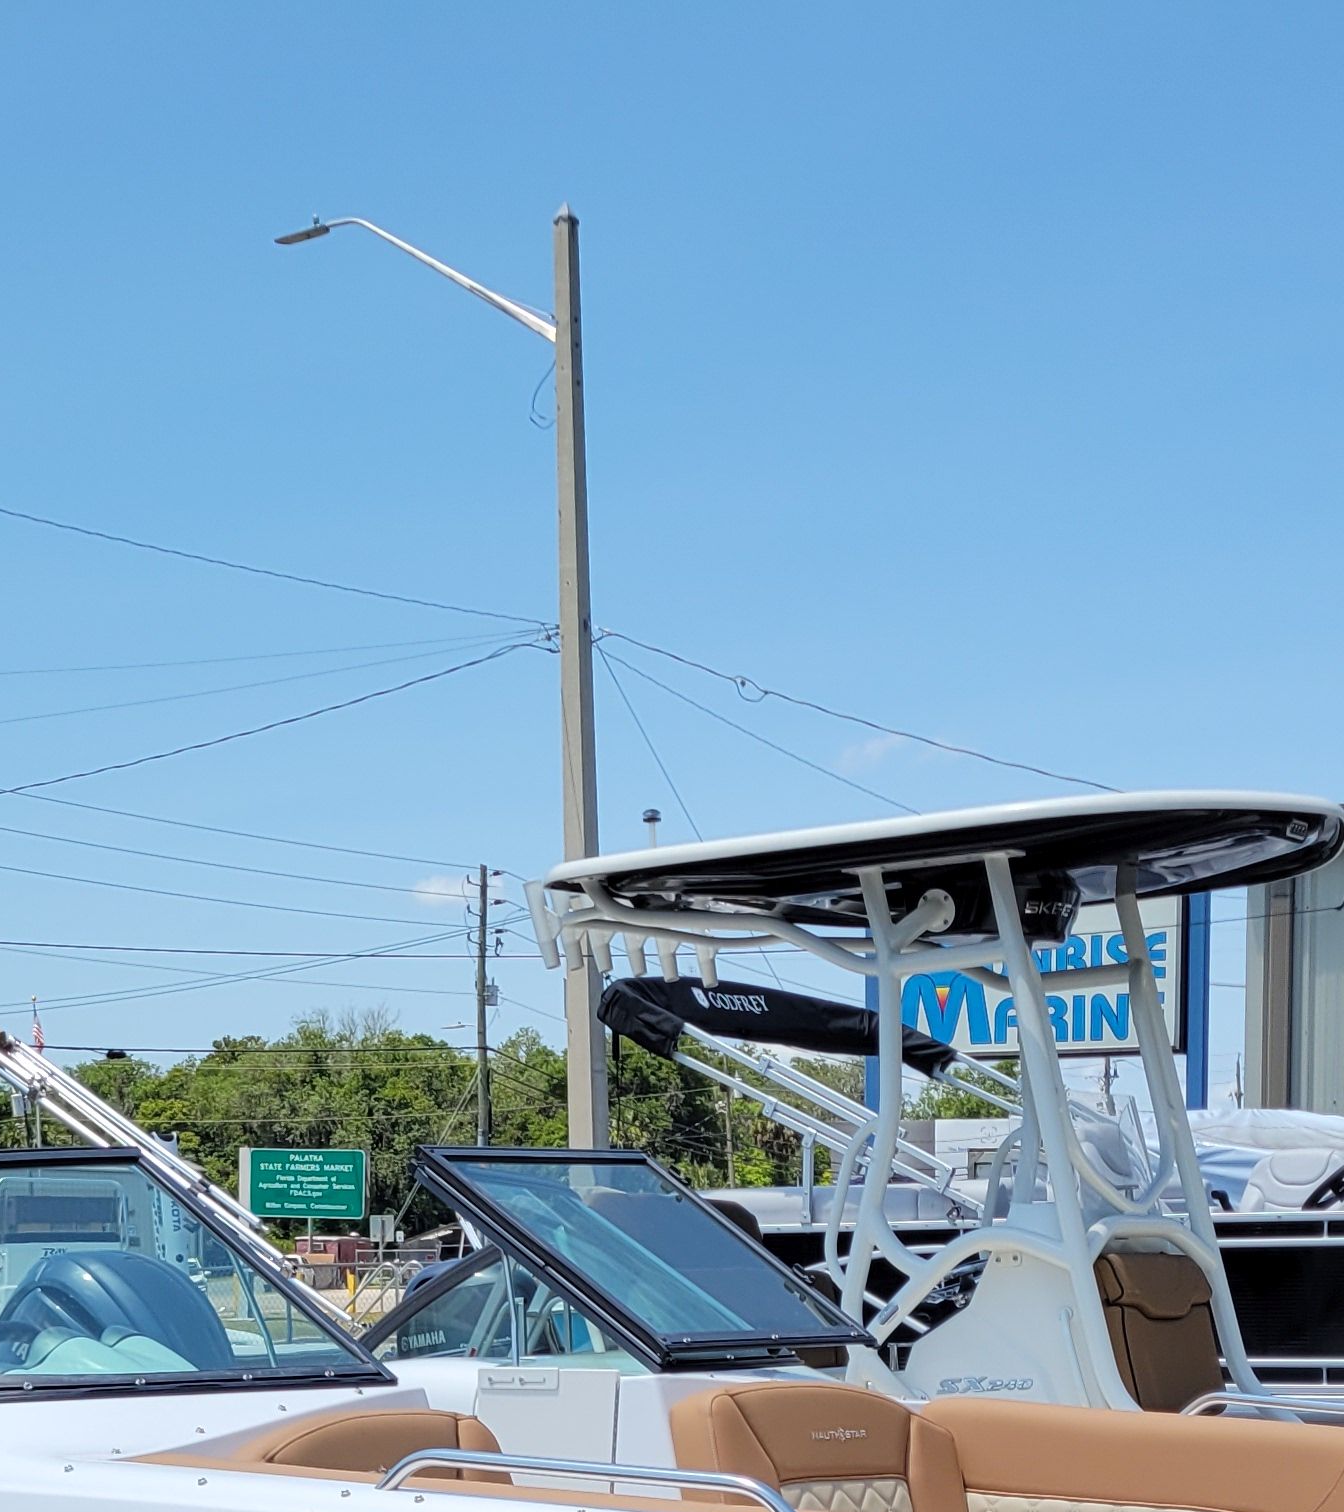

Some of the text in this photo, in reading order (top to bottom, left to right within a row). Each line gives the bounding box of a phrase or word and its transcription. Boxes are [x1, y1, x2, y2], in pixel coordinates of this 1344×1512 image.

[708, 991, 769, 1015] GODFREY
[901, 968, 1165, 1045] MARIN
[259, 1163, 354, 1172] STATE FARMERS MARKET
[289, 1154, 324, 1162] PALATKA
[408, 1329, 447, 1349] YAMAHA
